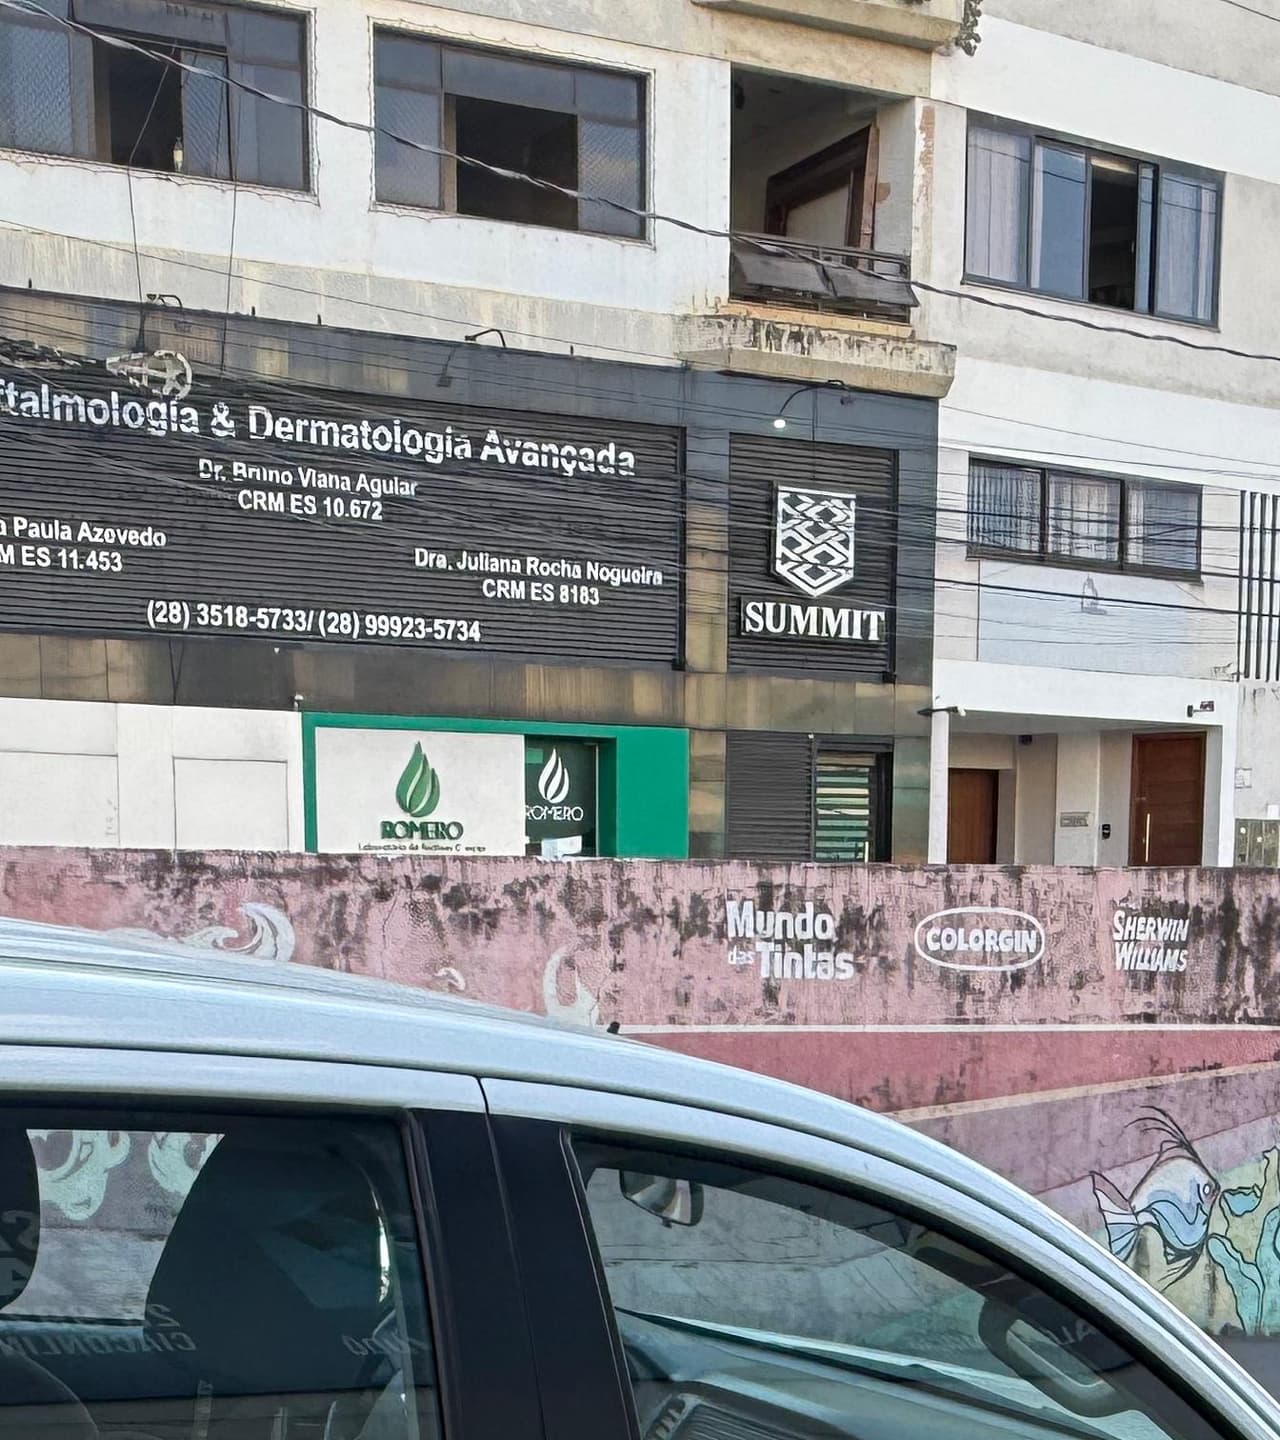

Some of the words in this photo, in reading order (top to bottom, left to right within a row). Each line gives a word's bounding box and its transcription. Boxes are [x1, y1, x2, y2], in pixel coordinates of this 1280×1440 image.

[211, 402, 235, 437] &
[248, 405, 472, 463] Dermatologia
[480, 428, 636, 477] Avançada
[198, 458, 226, 482] Dr.
[298, 467, 351, 492] Viana
[355, 473, 419, 499] Aguiar
[237, 489, 285, 513] CRM
[290, 493, 317, 516] ES
[323, 497, 383, 521] 10.672
[13, 516, 72, 542] Paula
[77, 521, 167, 547] Azevedo
[21, 545, 51, 568] ES
[57, 549, 122, 572] 11.453
[414, 547, 453, 571] Dra.
[457, 551, 521, 574] Juliana
[526, 556, 582, 579] Rocha
[586, 561, 663, 587] Nogueira
[482, 578, 526, 600] CRM
[530, 582, 555, 602] ES
[559, 586, 600, 606] 8183
[146, 599, 191, 630] (28)
[318, 609, 361, 640] (28)
[364, 615, 482, 642] 99923-5734
[745, 601, 886, 641] SUMMIT
[380, 820, 465, 841] ROMERO
[726, 900, 835, 940] Mundo
[1113, 910, 1190, 942] SHERWIN
[926, 927, 1038, 954] COLORGIN
[1114, 941, 1189, 972] WILLIAMS
[728, 944, 754, 966] das
[756, 941, 855, 980] Tintas
